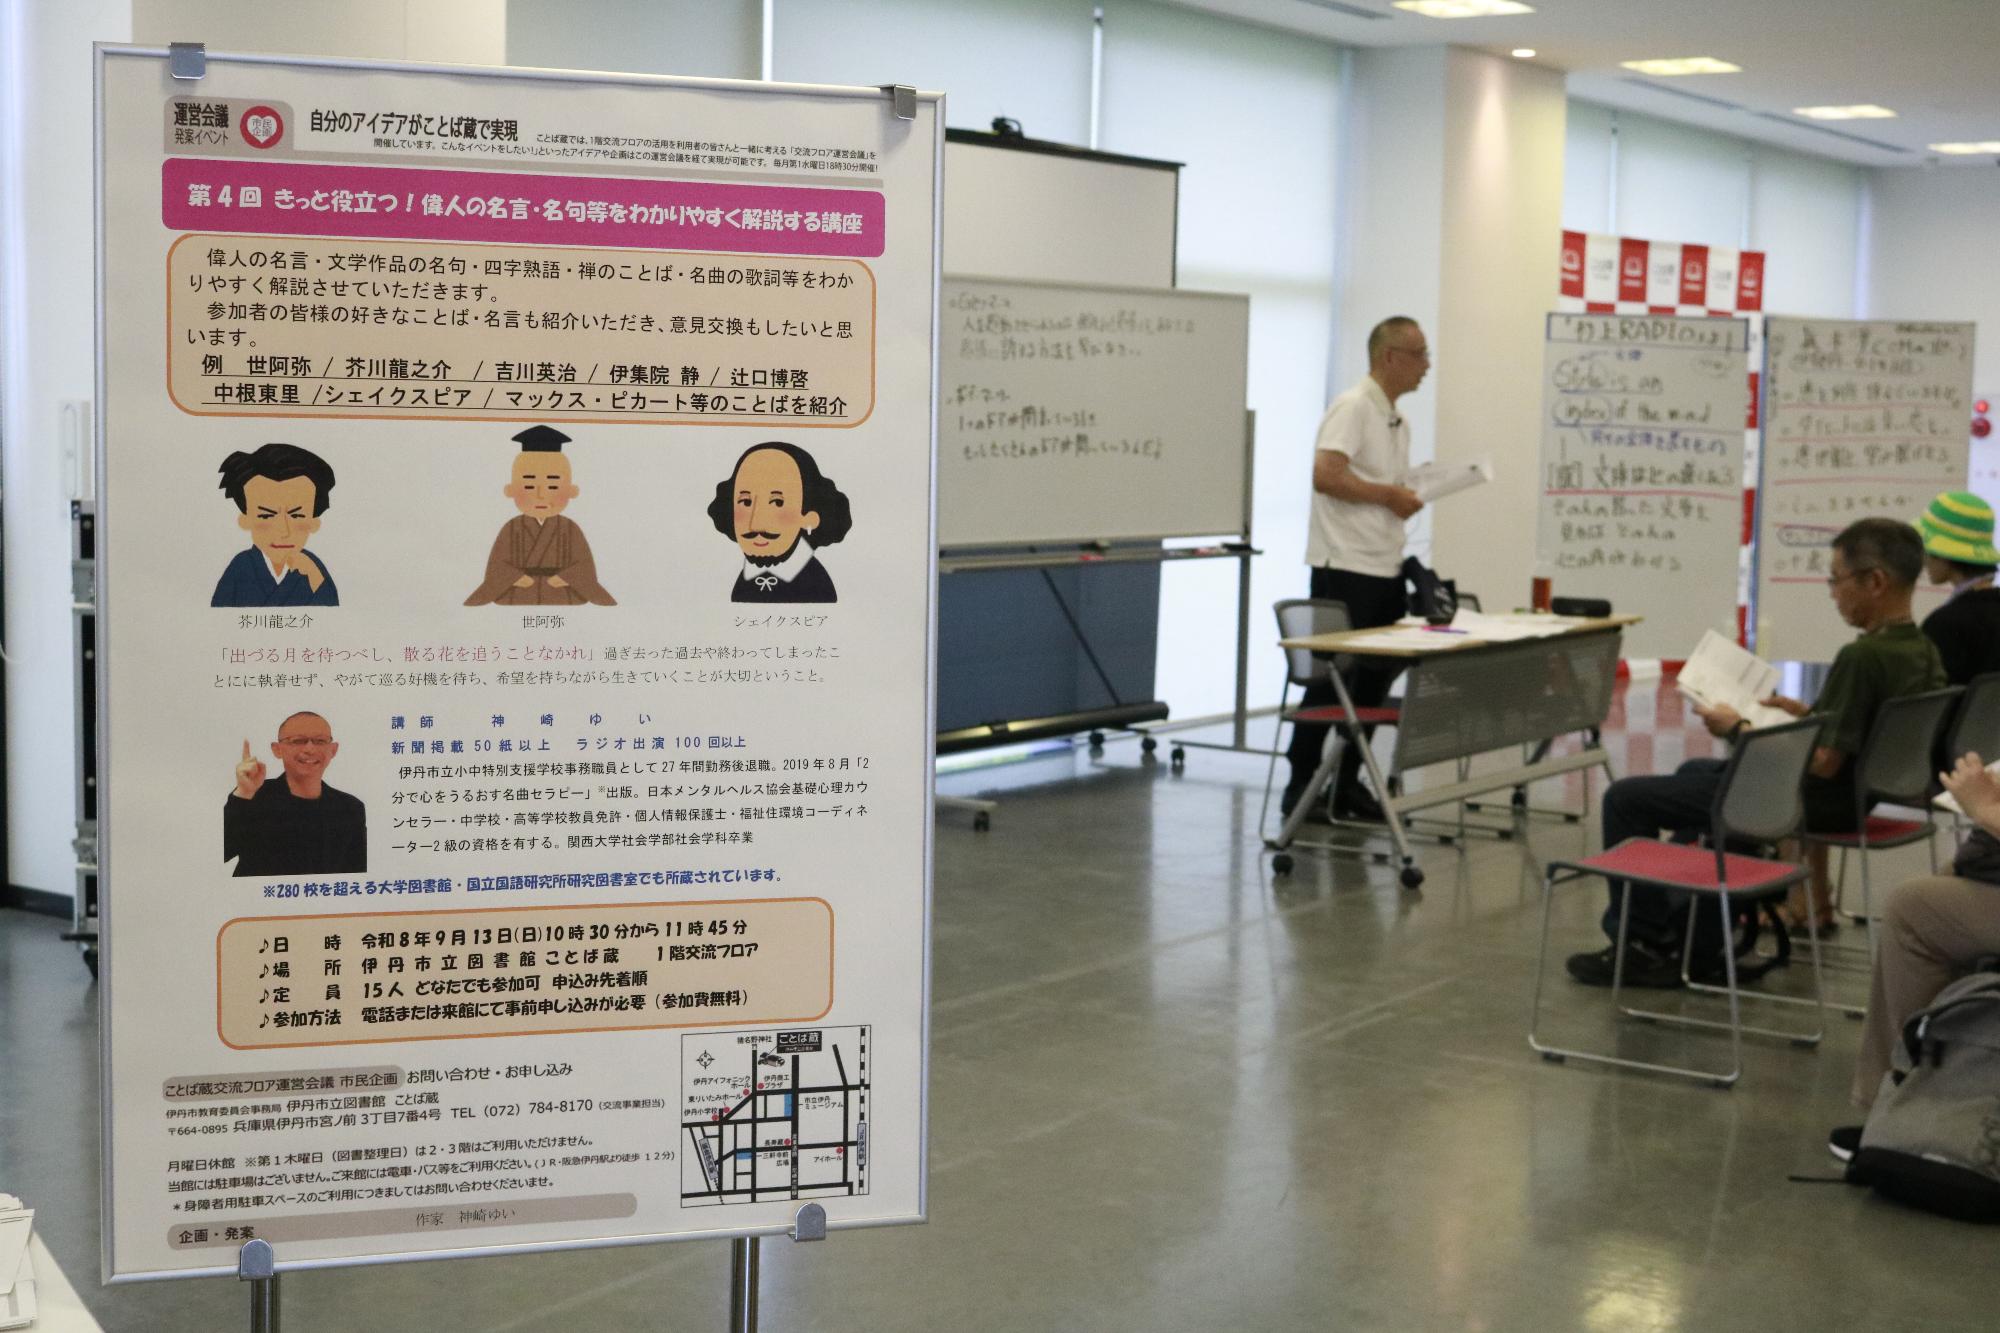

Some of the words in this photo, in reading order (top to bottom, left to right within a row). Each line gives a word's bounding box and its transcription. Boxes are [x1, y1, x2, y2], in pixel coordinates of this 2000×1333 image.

[174, 102, 229, 129] 運営会議
[310, 108, 518, 142] 自分のアイデアがことば蔵で実現
[174, 128, 229, 146] 発案イベント
[207, 248, 854, 289] 偉人の名言・文学作品の名句・四字熟語・禅のことば・名曲の歌詞等をわか
[190, 274, 497, 303] りやすく解説させていただきます。
[207, 301, 853, 339] 参加者の皆様の好きなことば・名言も紹介いただき、意見交換もしたいと思
[187, 328, 256, 348] います。
[202, 354, 223, 376] 例
[247, 355, 312, 376] 世阿弥
[345, 357, 451, 380] 芥川龍之介
[495, 361, 577, 383] 吉川英治
[731, 368, 809, 389] 辻口博啓
[214, 383, 300, 404] 中根東里
[238, 613, 314, 629] 芥川龍之介
[522, 614, 564, 629] 世阿弥
[734, 614, 829, 628] シェイクスピア
[364, 981, 404, 999] 15人
[415, 974, 541, 996] どなたでも参加可
[552, 970, 648, 990] 申込み先着順
[273, 1009, 342, 1028] 参加方法
[166, 1076, 334, 1097] ことば蔵交流フロア運営会議
[340, 1072, 398, 1088] 市民企画
[407, 1062, 573, 1084] お問い合わせ・お申し込み
[166, 1103, 282, 1119] 伊丹市教育委員会事務局
[287, 1095, 386, 1113] 伊丹市立図書館
[395, 1092, 440, 1106] ことば蔵
[233, 1115, 356, 1133] 兵庫県伊丹市宮ノ前
[361, 1108, 441, 1125] 3丁目7番4号
[450, 1107, 476, 1119] TEL
[529, 1099, 593, 1114] 784-8170
[167, 1157, 235, 1172] 月曜日休館
[179, 1225, 255, 1244] 企画・発案
[416, 1212, 444, 1227] 作家
[459, 1208, 516, 1224] 神崎ゆい
